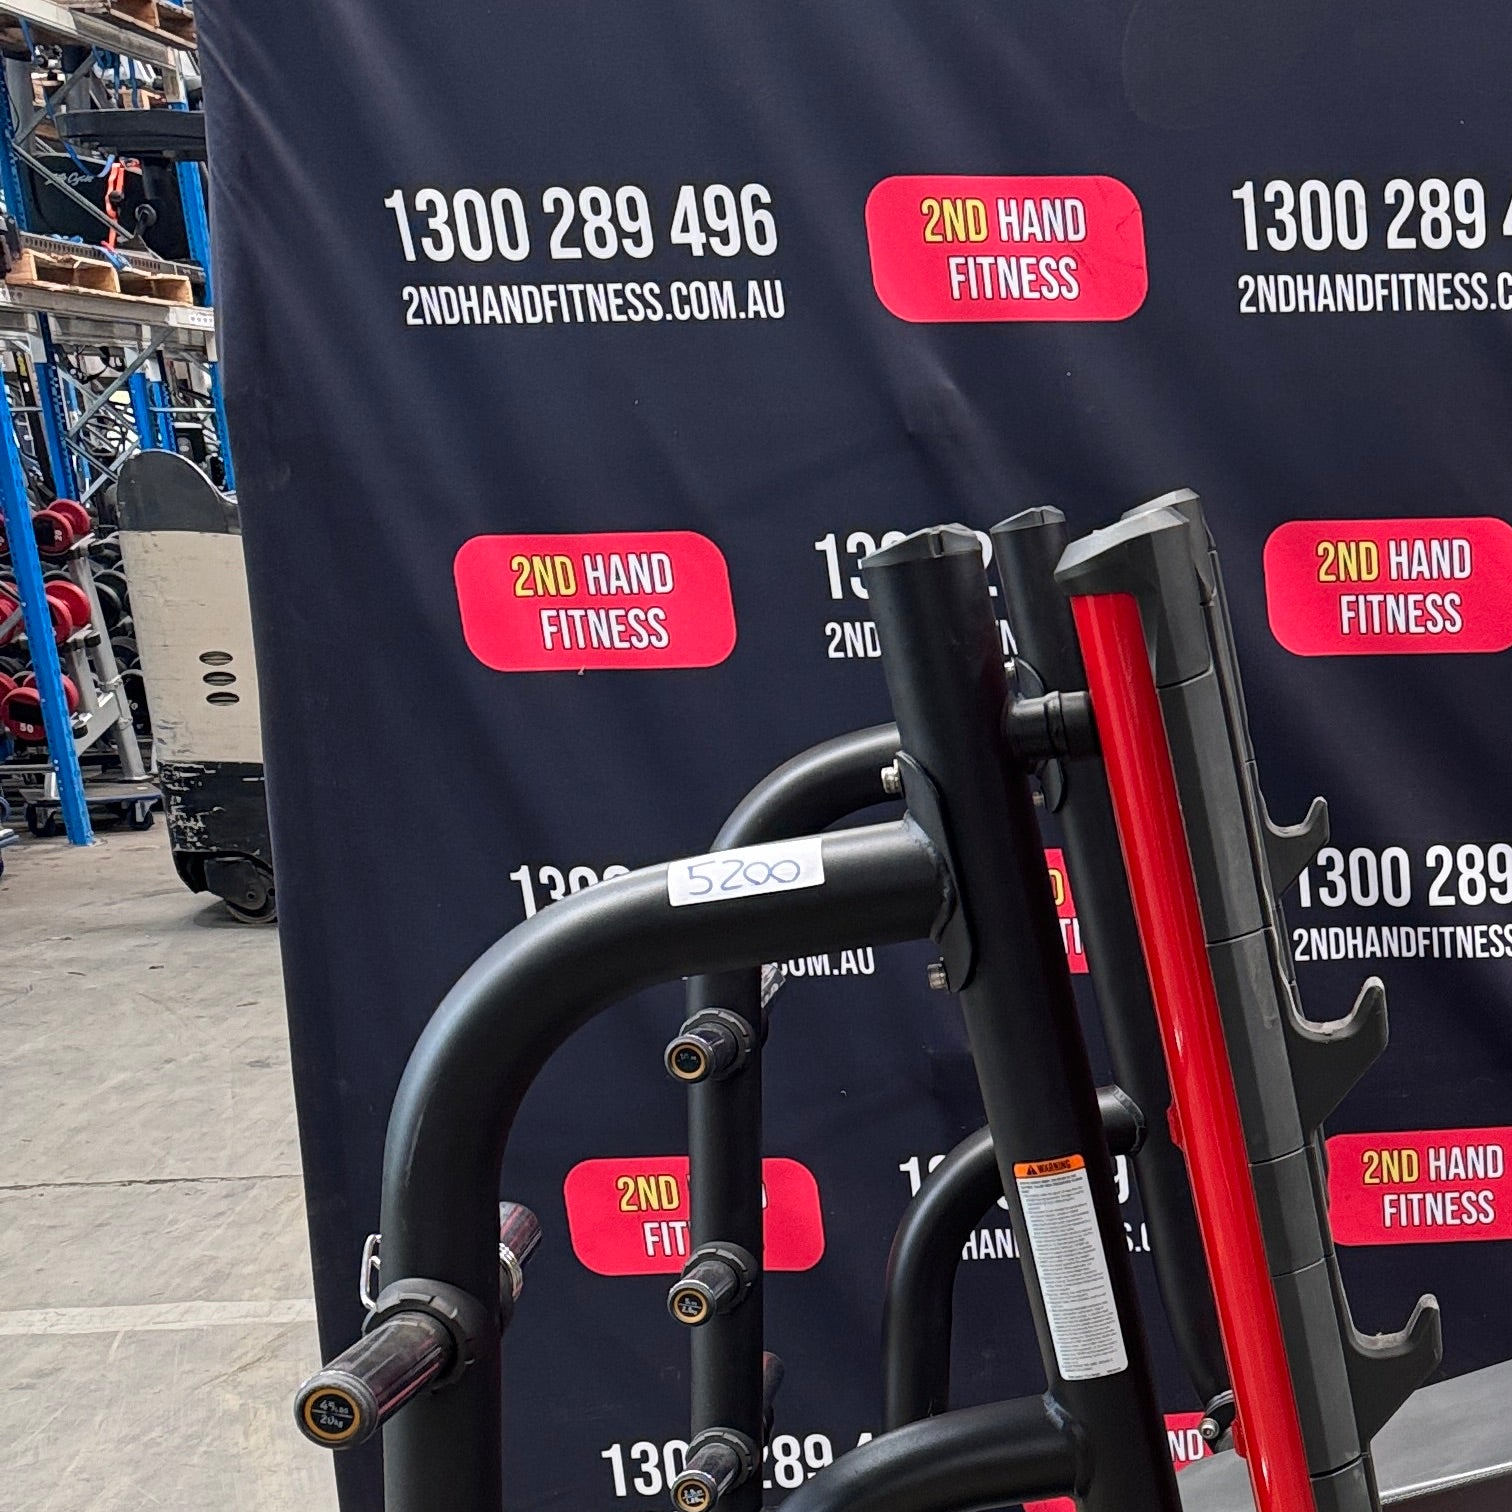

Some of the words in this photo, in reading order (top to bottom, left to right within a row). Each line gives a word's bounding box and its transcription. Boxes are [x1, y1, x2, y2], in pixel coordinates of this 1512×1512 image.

[385, 188, 529, 261] 1300
[543, 186, 653, 259] 289
[671, 184, 777, 256] 496
[922, 199, 987, 241] 2ND
[998, 199, 1085, 241] HAND
[1233, 180, 1367, 251] 1300
[1385, 179, 1486, 249] 289
[949, 257, 1078, 299] FITNESS
[403, 280, 784, 325] 2NDHANDFITNESS.COM.AU
[512, 556, 576, 596] 2ND
[584, 554, 673, 594] HAND
[1318, 542, 1378, 581] 2ND
[1389, 540, 1470, 579] HAND
[541, 608, 668, 649] FITNESS
[1341, 593, 1461, 633] FITNESS
[20, 722, 34, 734] 50
[688, 859, 801, 896] 5200
[1364, 1150, 1418, 1183] 2ND
[1429, 1146, 1503, 1180] HAND
[618, 1176, 679, 1210] 2ND
[1384, 1191, 1494, 1226] FITNESS
[602, 1440, 688, 1497] 130
